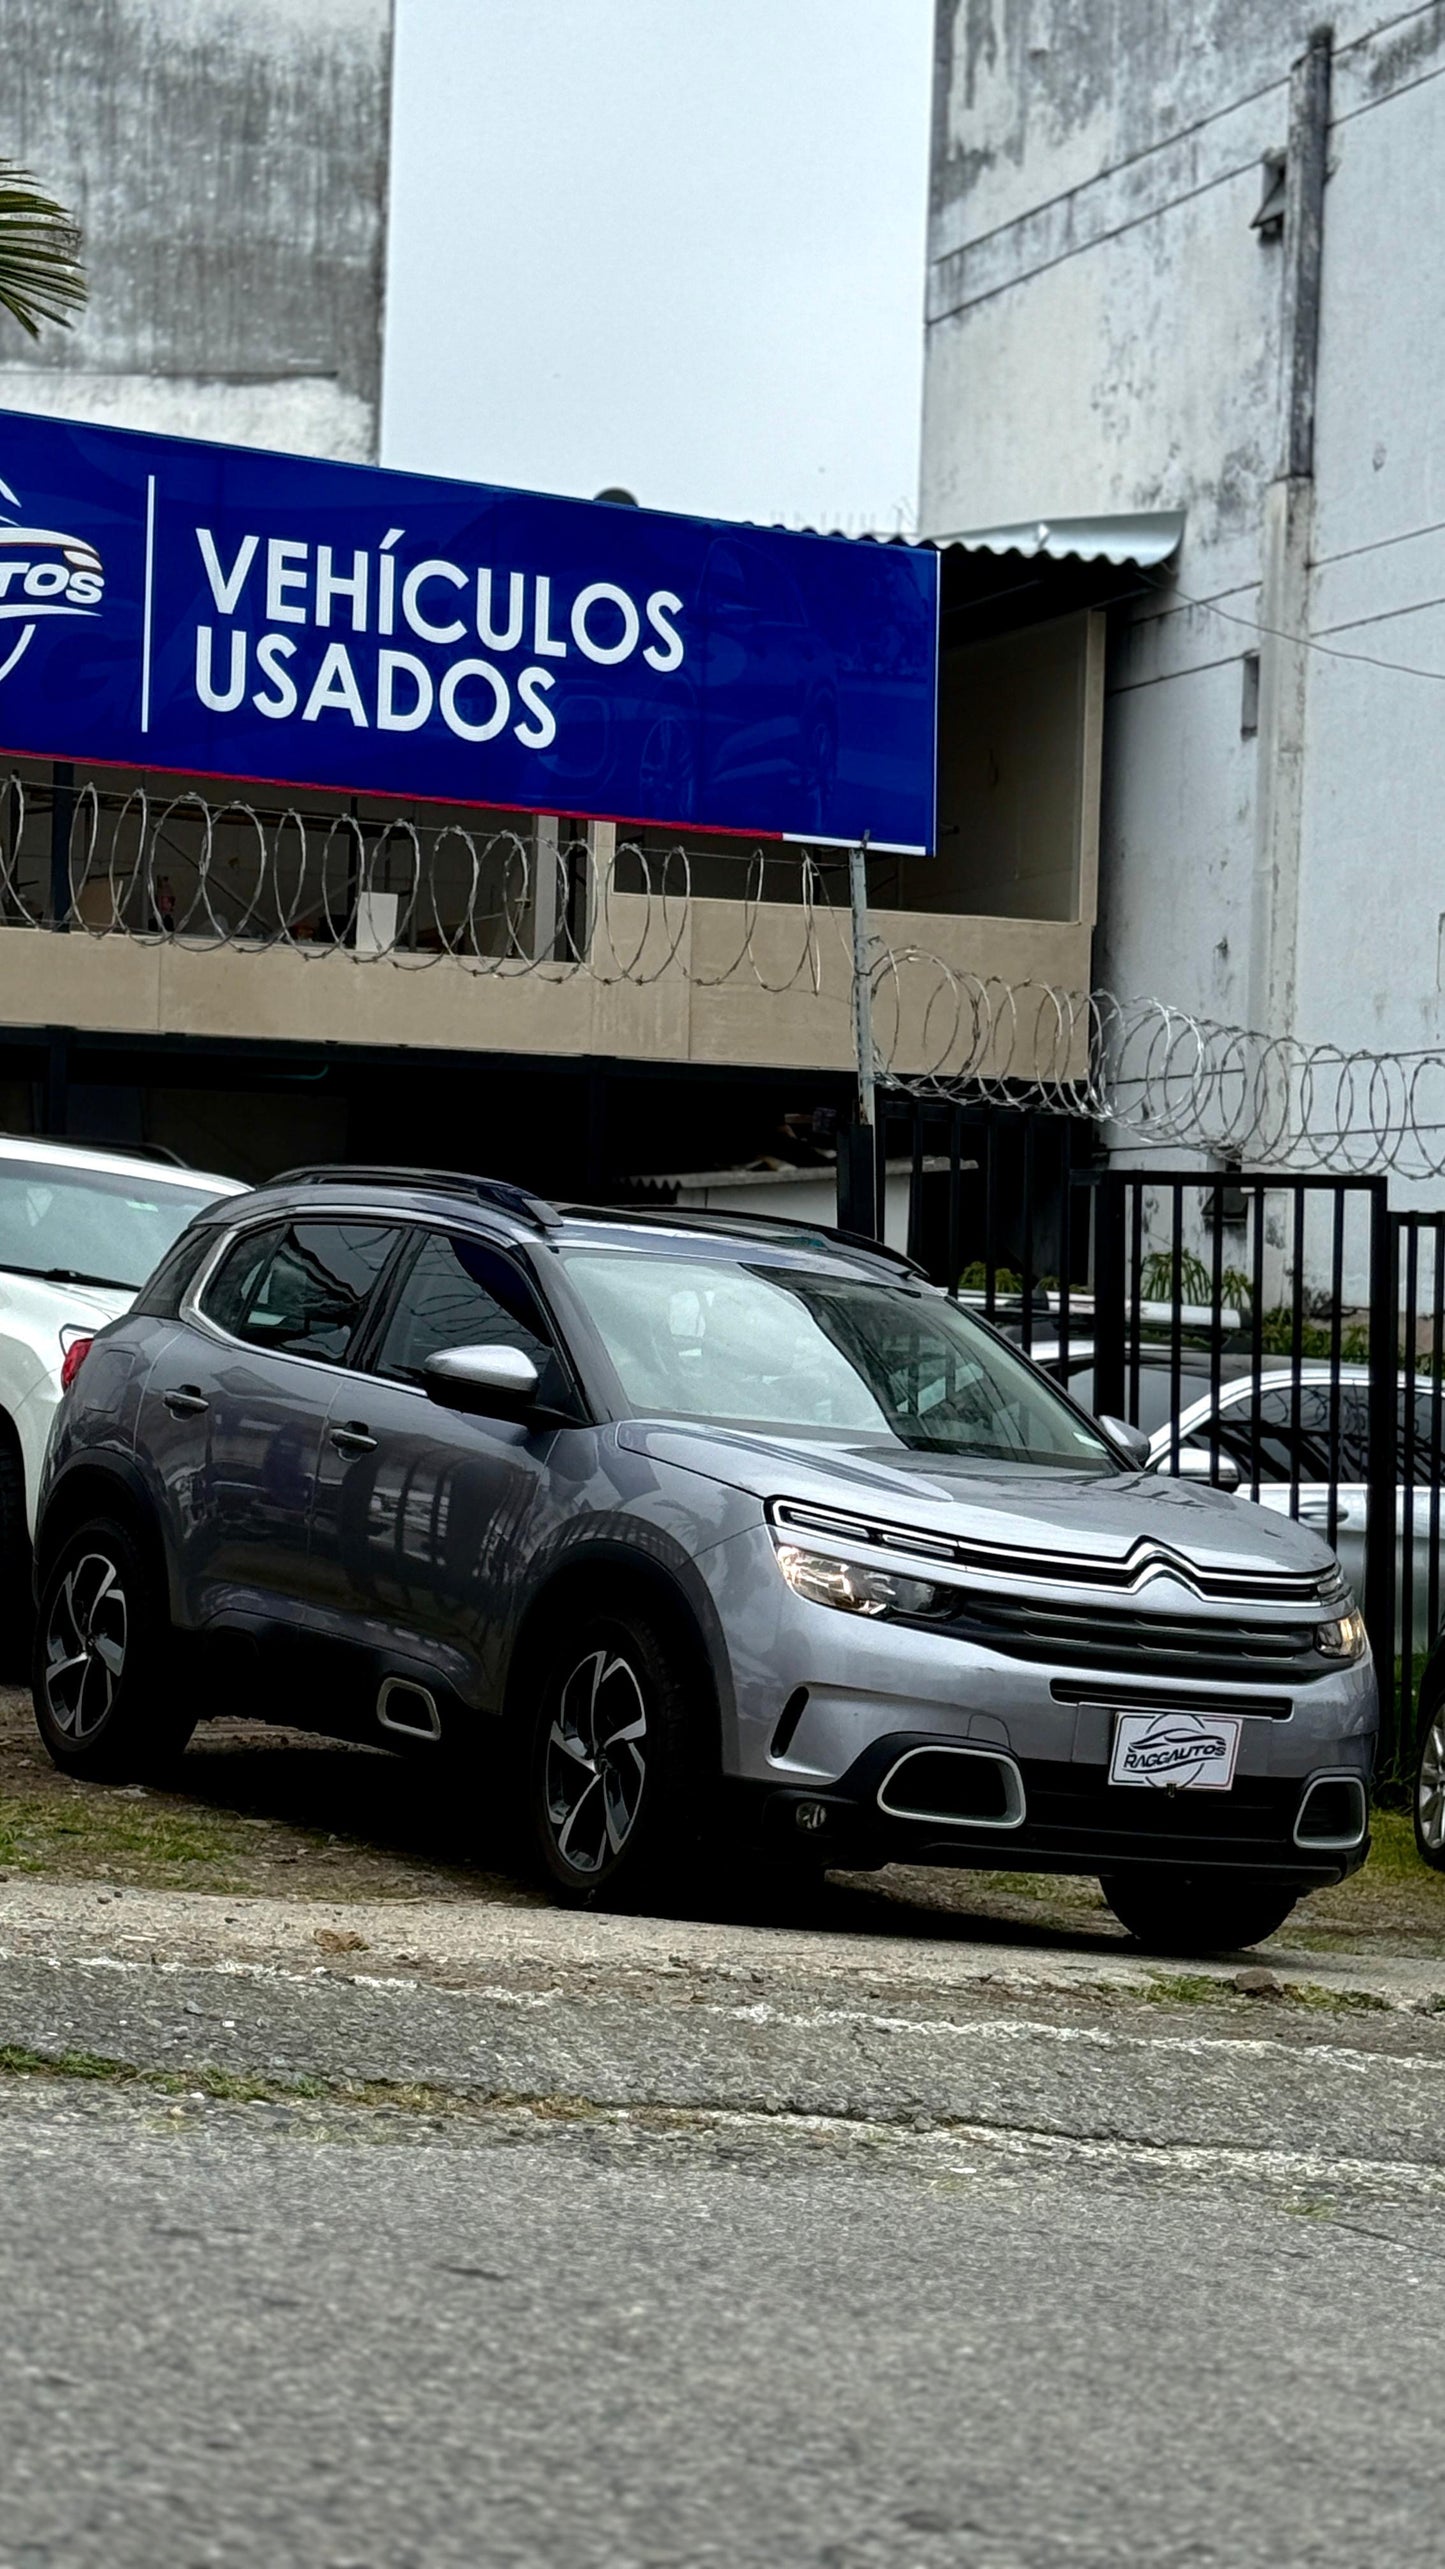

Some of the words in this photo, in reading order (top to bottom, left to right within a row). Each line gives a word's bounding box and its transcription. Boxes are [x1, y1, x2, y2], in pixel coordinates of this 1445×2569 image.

[195, 528, 685, 673] VEHÍCULOS
[195, 625, 557, 750] USADOS
[1123, 1744, 1227, 1768] RAGGAUTOS
